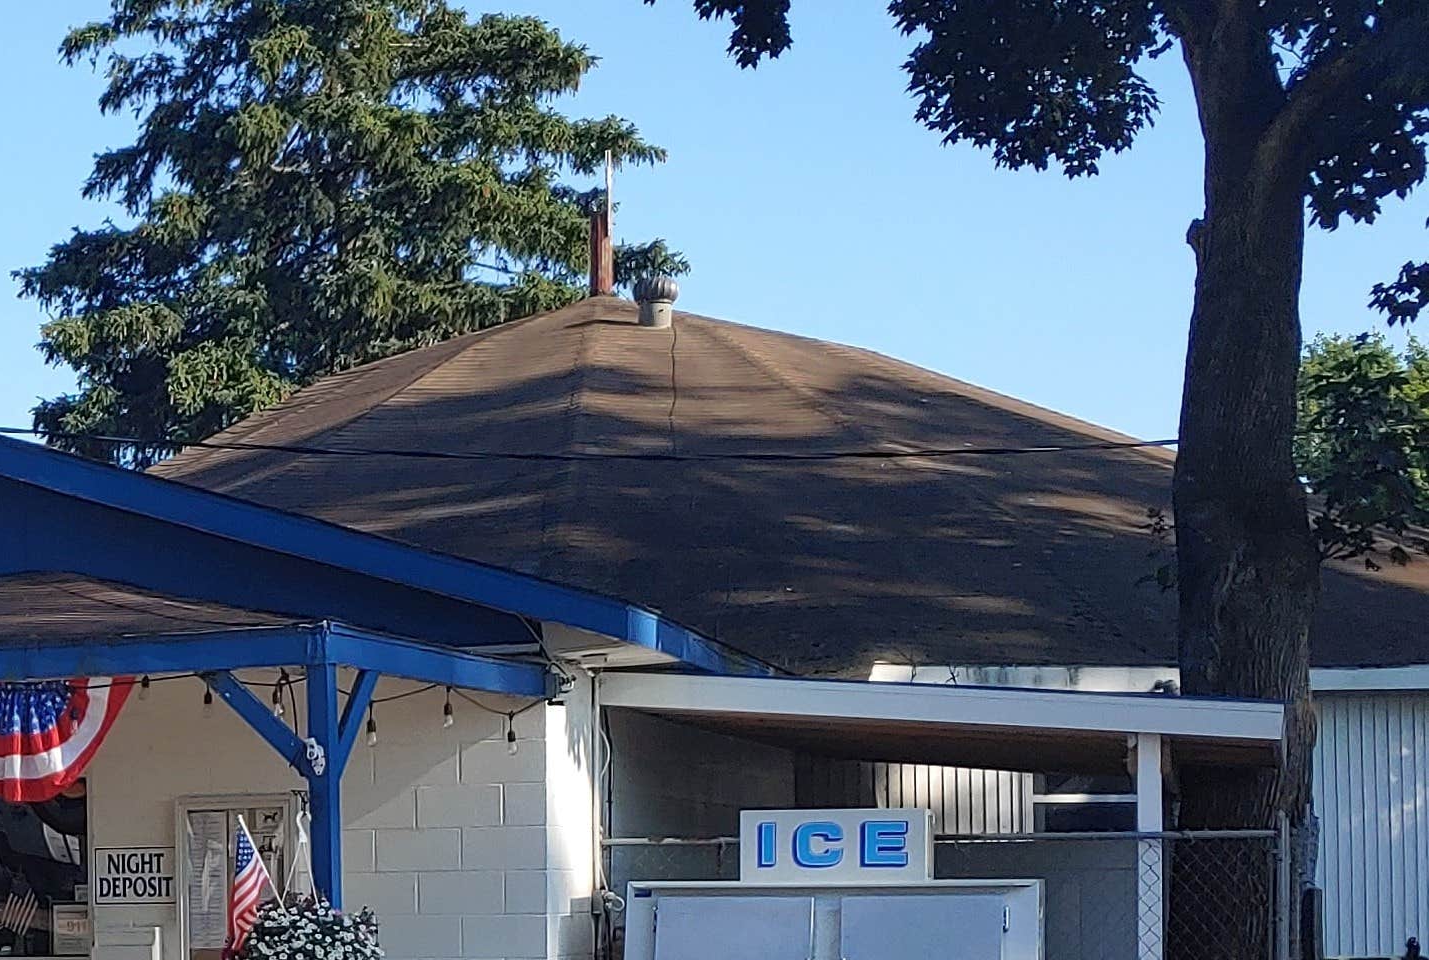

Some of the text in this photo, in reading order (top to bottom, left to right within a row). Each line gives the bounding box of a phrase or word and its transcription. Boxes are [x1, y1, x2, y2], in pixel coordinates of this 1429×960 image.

[756, 820, 909, 869] ICE
[107, 853, 164, 874] NIGHT
[99, 876, 173, 897] DEPOSIT
